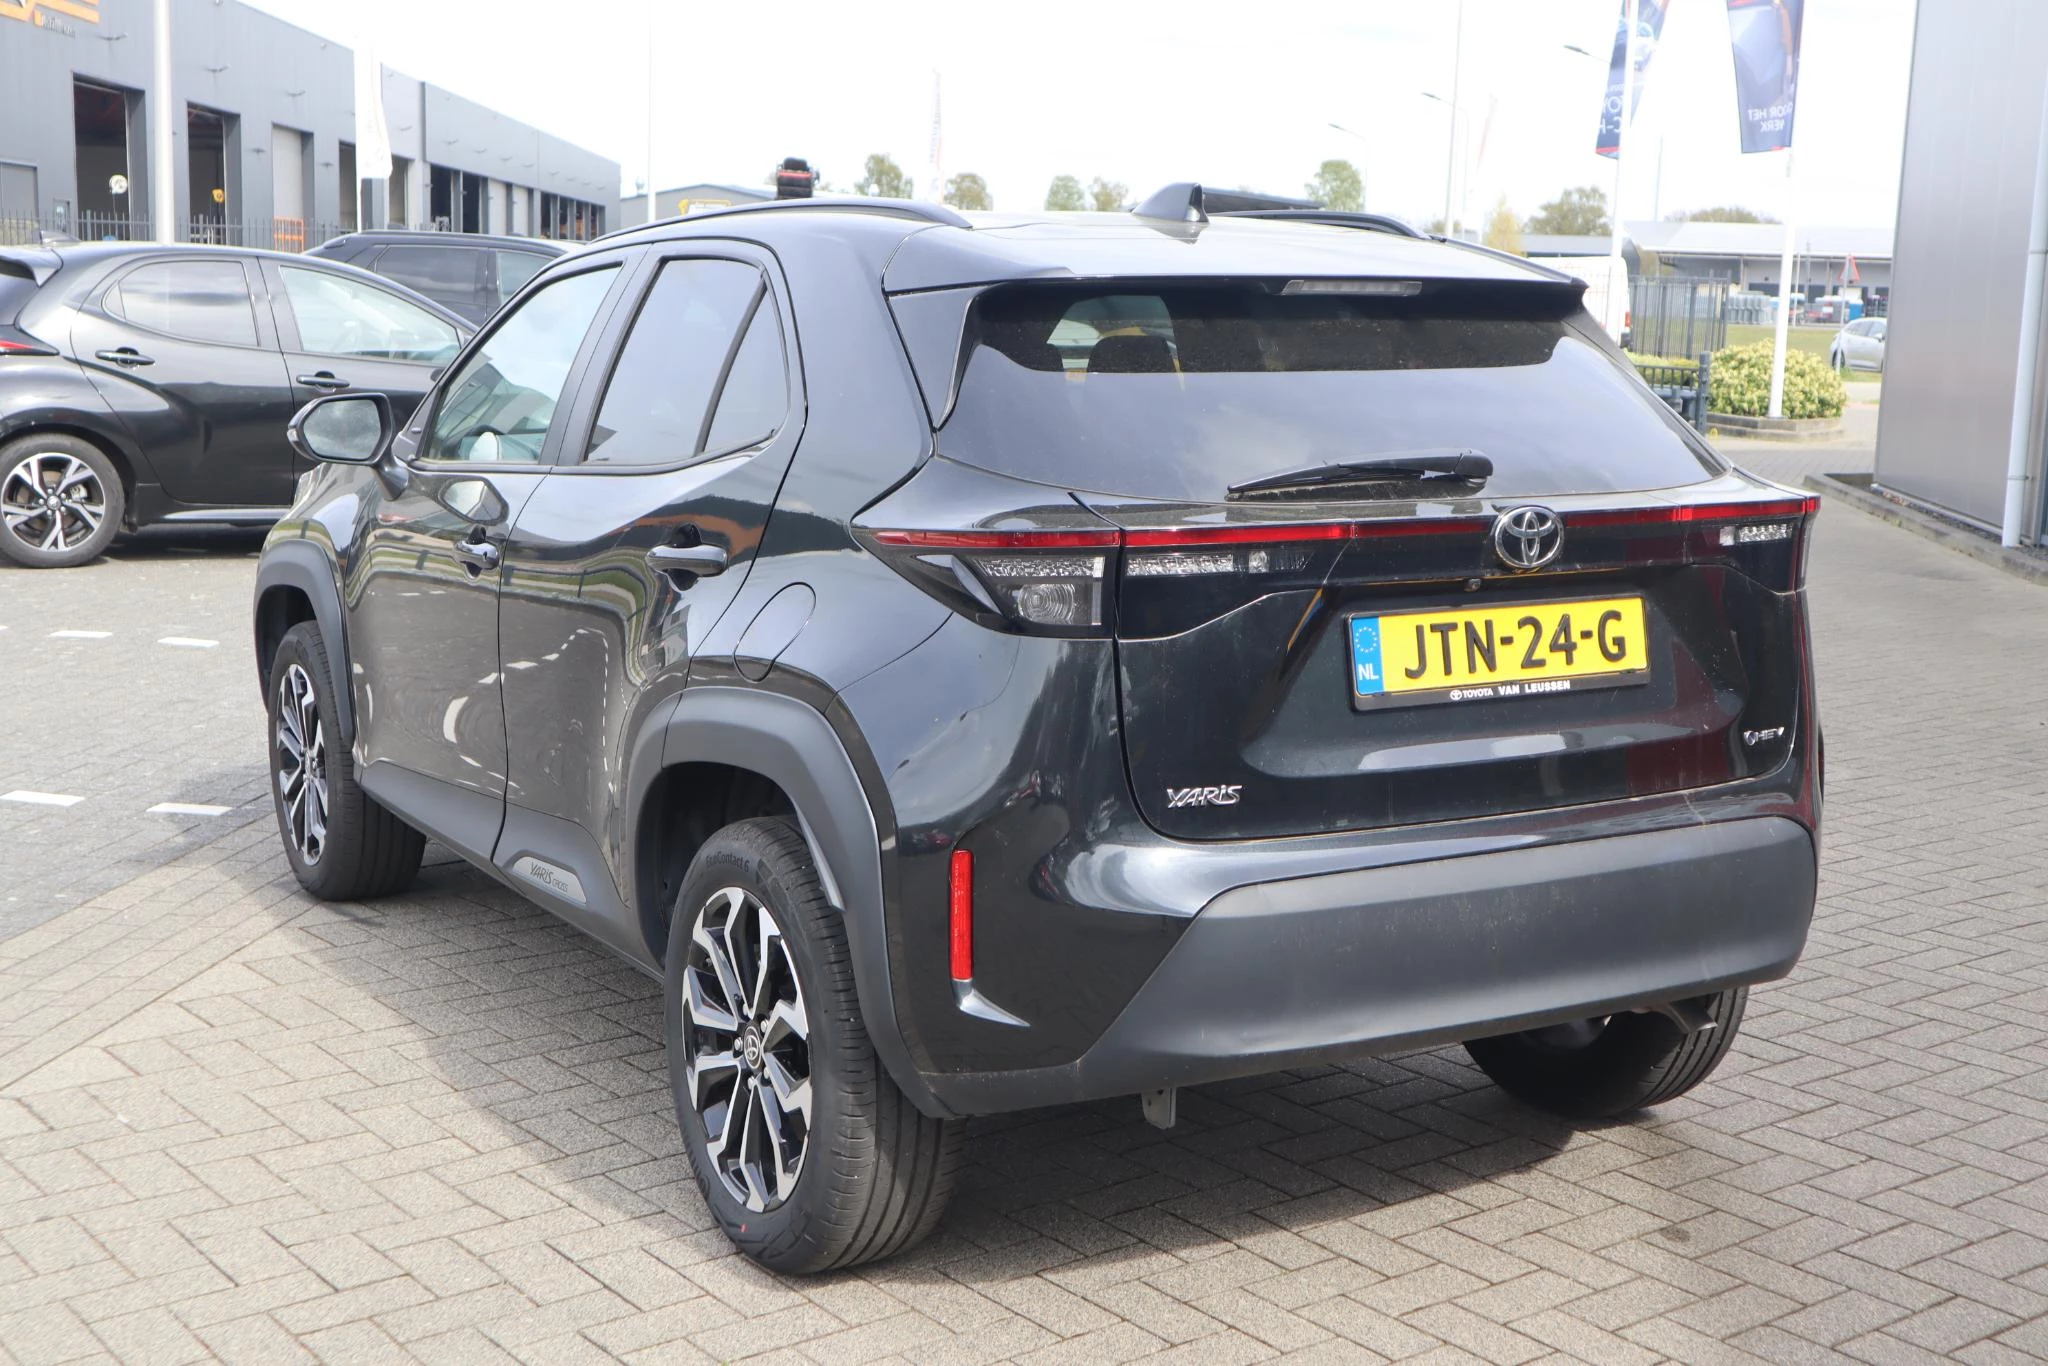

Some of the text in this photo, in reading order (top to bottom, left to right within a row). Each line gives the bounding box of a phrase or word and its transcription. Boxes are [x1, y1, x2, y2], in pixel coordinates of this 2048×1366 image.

[1405, 610, 1626, 679] JTN-24-G
[1358, 663, 1379, 681] NL
[1462, 680, 1571, 699] TOYOTA VAN LEUSSEN
